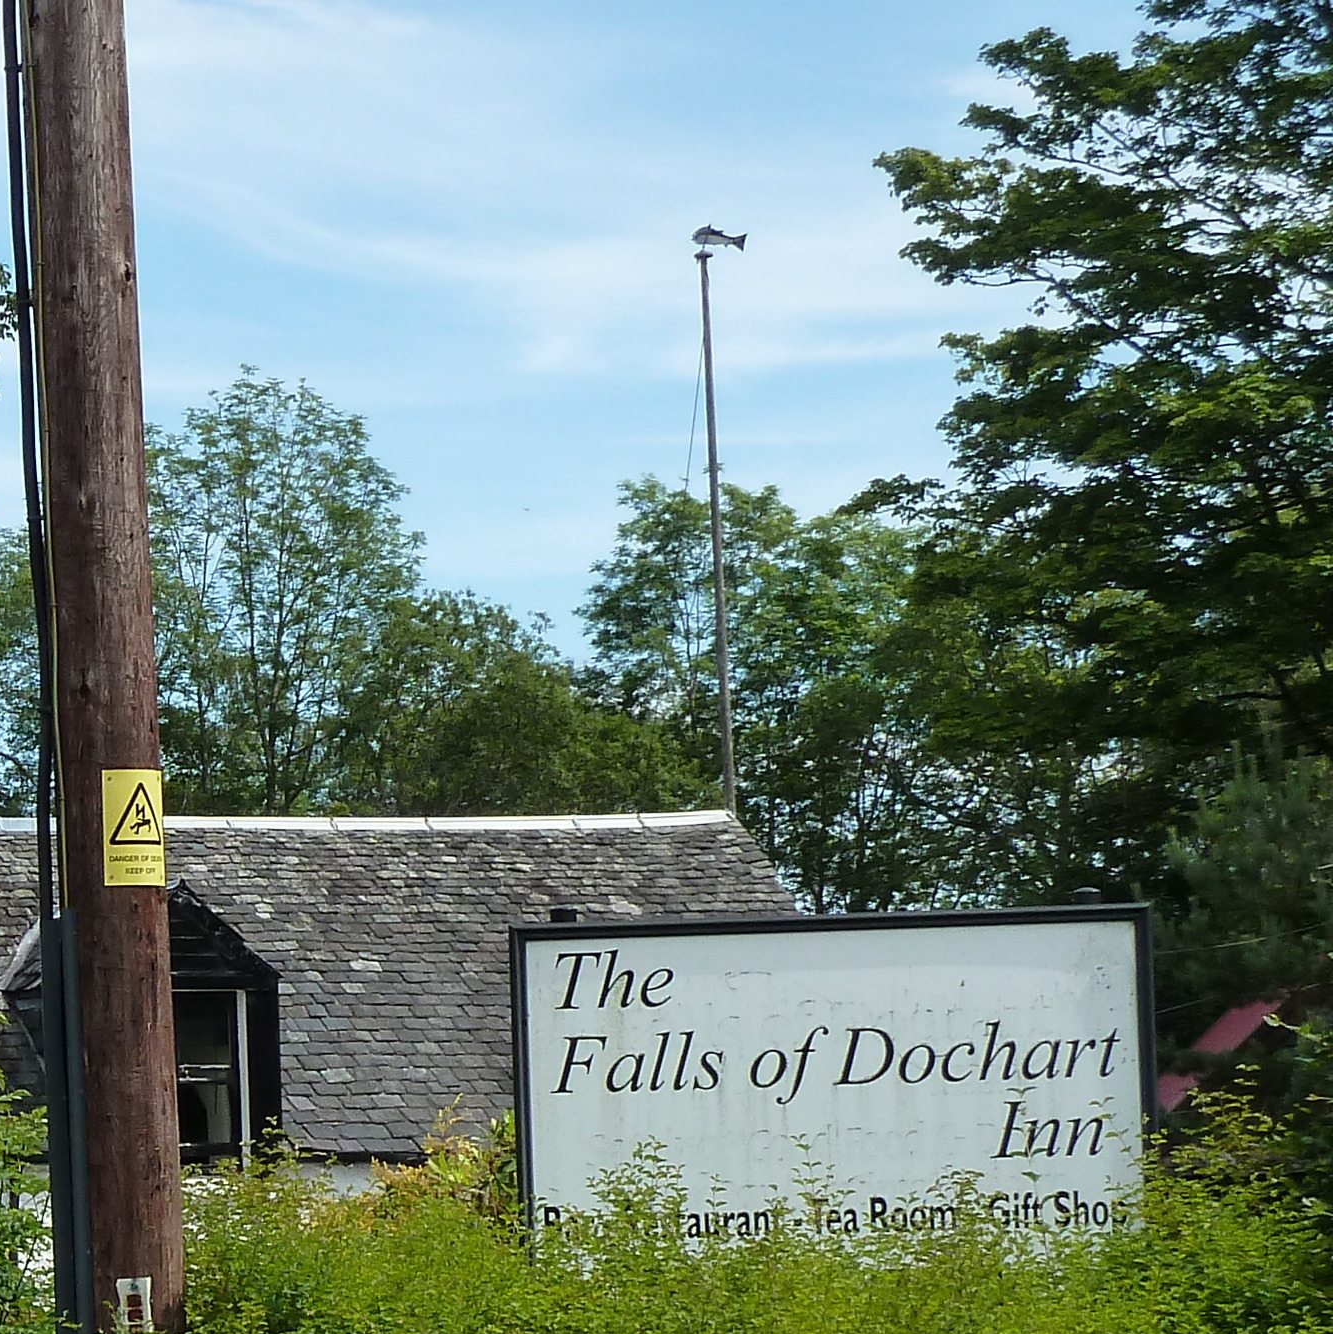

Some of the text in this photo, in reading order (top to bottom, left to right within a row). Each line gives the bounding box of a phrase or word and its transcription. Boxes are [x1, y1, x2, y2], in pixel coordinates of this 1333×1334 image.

[554, 948, 674, 1011] The
[550, 1019, 1122, 1105] Falls of Dochart
[990, 1099, 1106, 1160] Inn
[811, 1198, 861, 1235] Tea
[989, 1191, 1043, 1230] Gift
